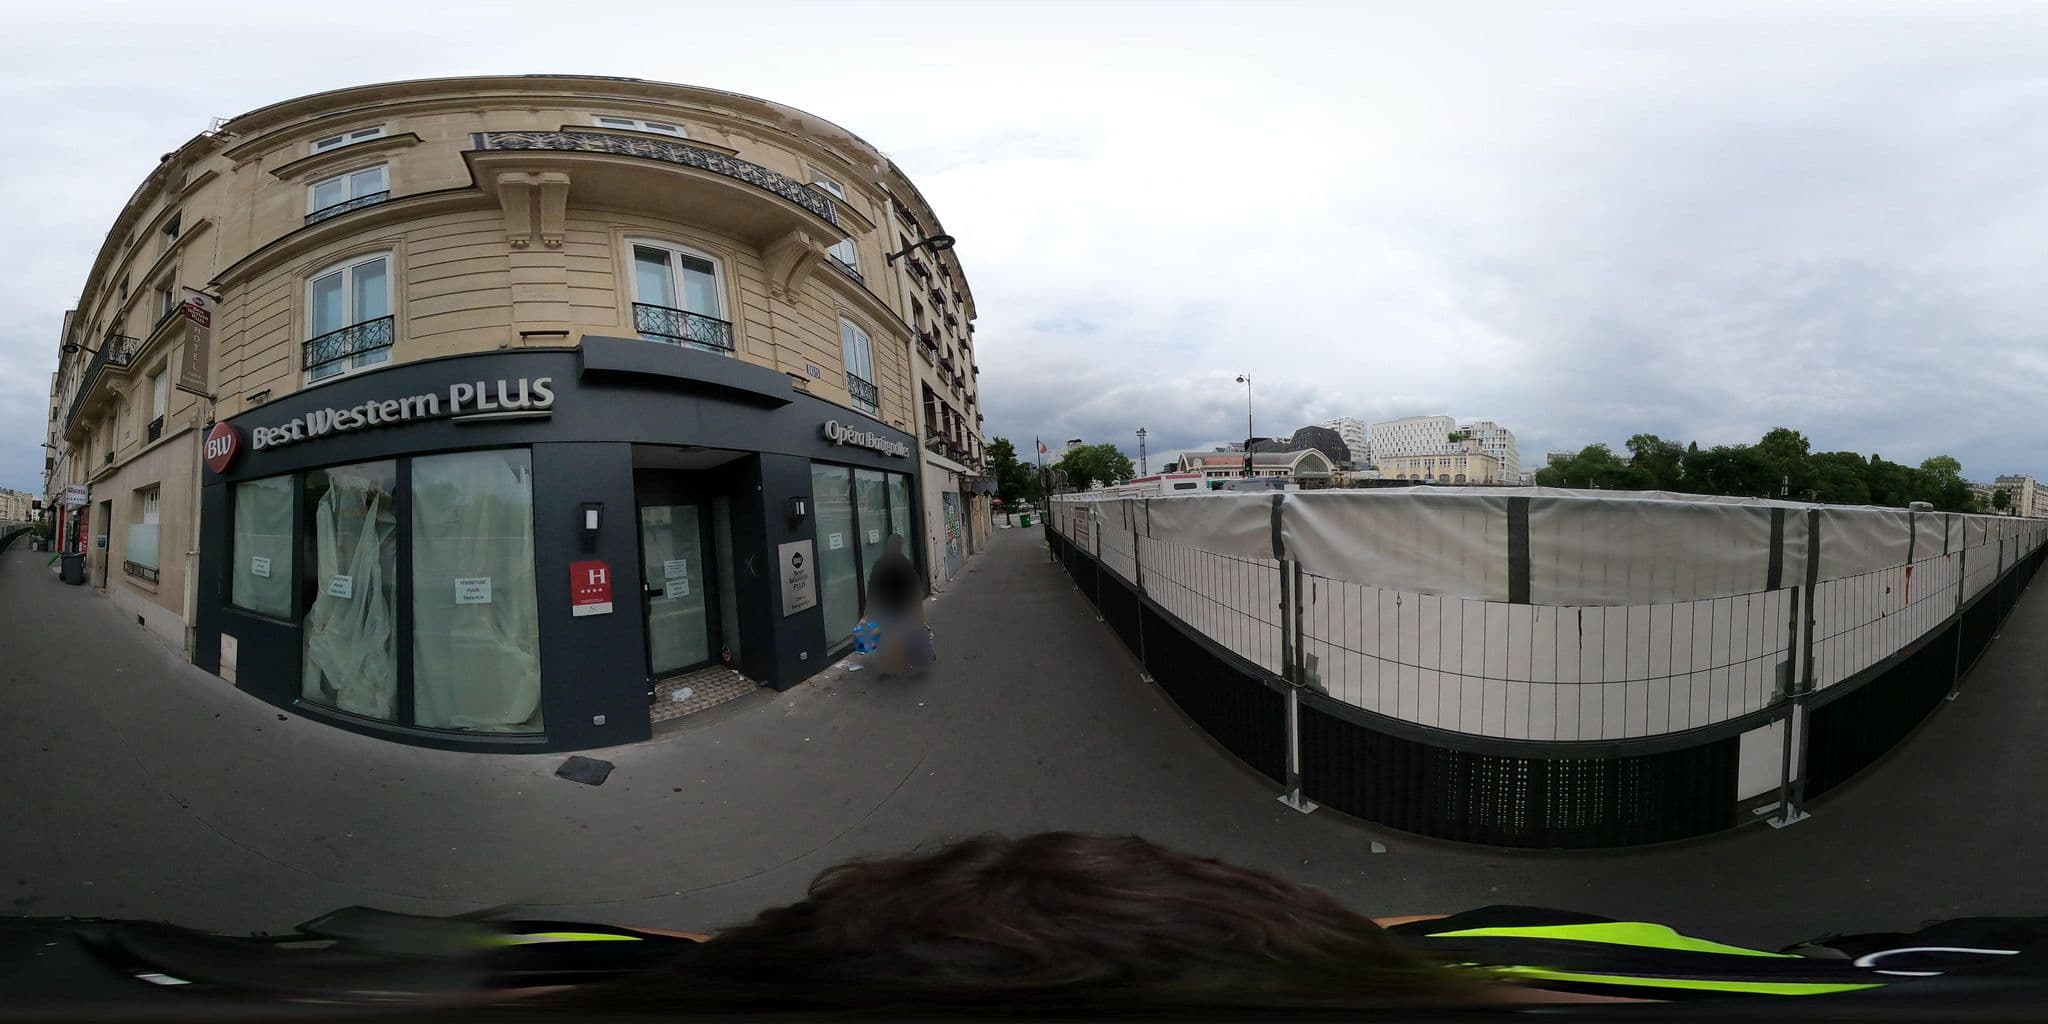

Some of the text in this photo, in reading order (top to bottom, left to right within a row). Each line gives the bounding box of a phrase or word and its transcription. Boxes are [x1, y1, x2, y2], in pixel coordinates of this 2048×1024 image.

[192, 327, 201, 370] HOTEL
[252, 377, 555, 450] Best Western PLUS
[207, 434, 231, 460] BW
[824, 419, 910, 459] Opéra Batignolles
[588, 568, 606, 585] H
